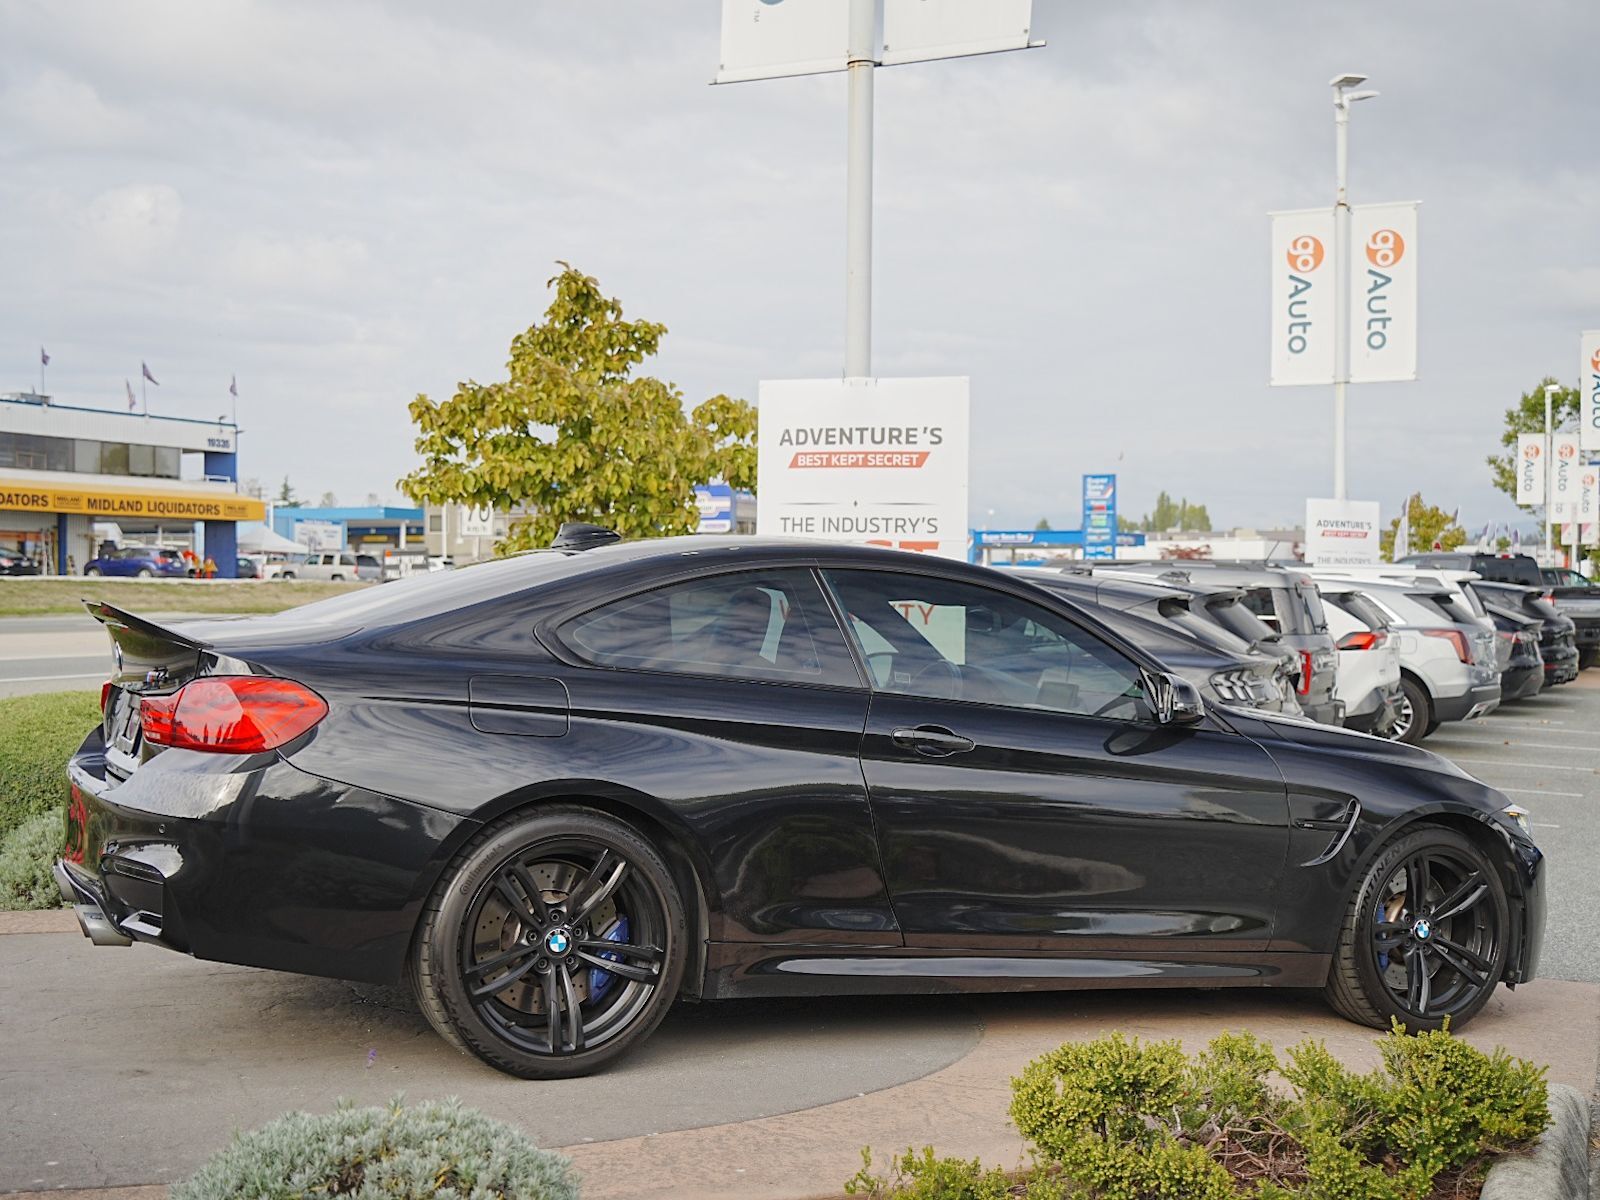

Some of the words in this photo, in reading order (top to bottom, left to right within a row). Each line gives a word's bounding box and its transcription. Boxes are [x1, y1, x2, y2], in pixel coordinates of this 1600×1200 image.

[1287, 274, 1313, 354] Auto
[1366, 268, 1393, 350] Auto
[779, 426, 943, 447] ADVENTURE'S
[797, 454, 829, 466] BEST
[831, 454, 865, 466] KEPT
[867, 454, 919, 466] SECRET
[0, 493, 49, 507] DATORS
[87, 497, 143, 512] MIDLAND
[147, 501, 221, 515] LIQUIDATORS
[780, 516, 815, 533] THE
[822, 516, 939, 534] INDUSTRY'S
